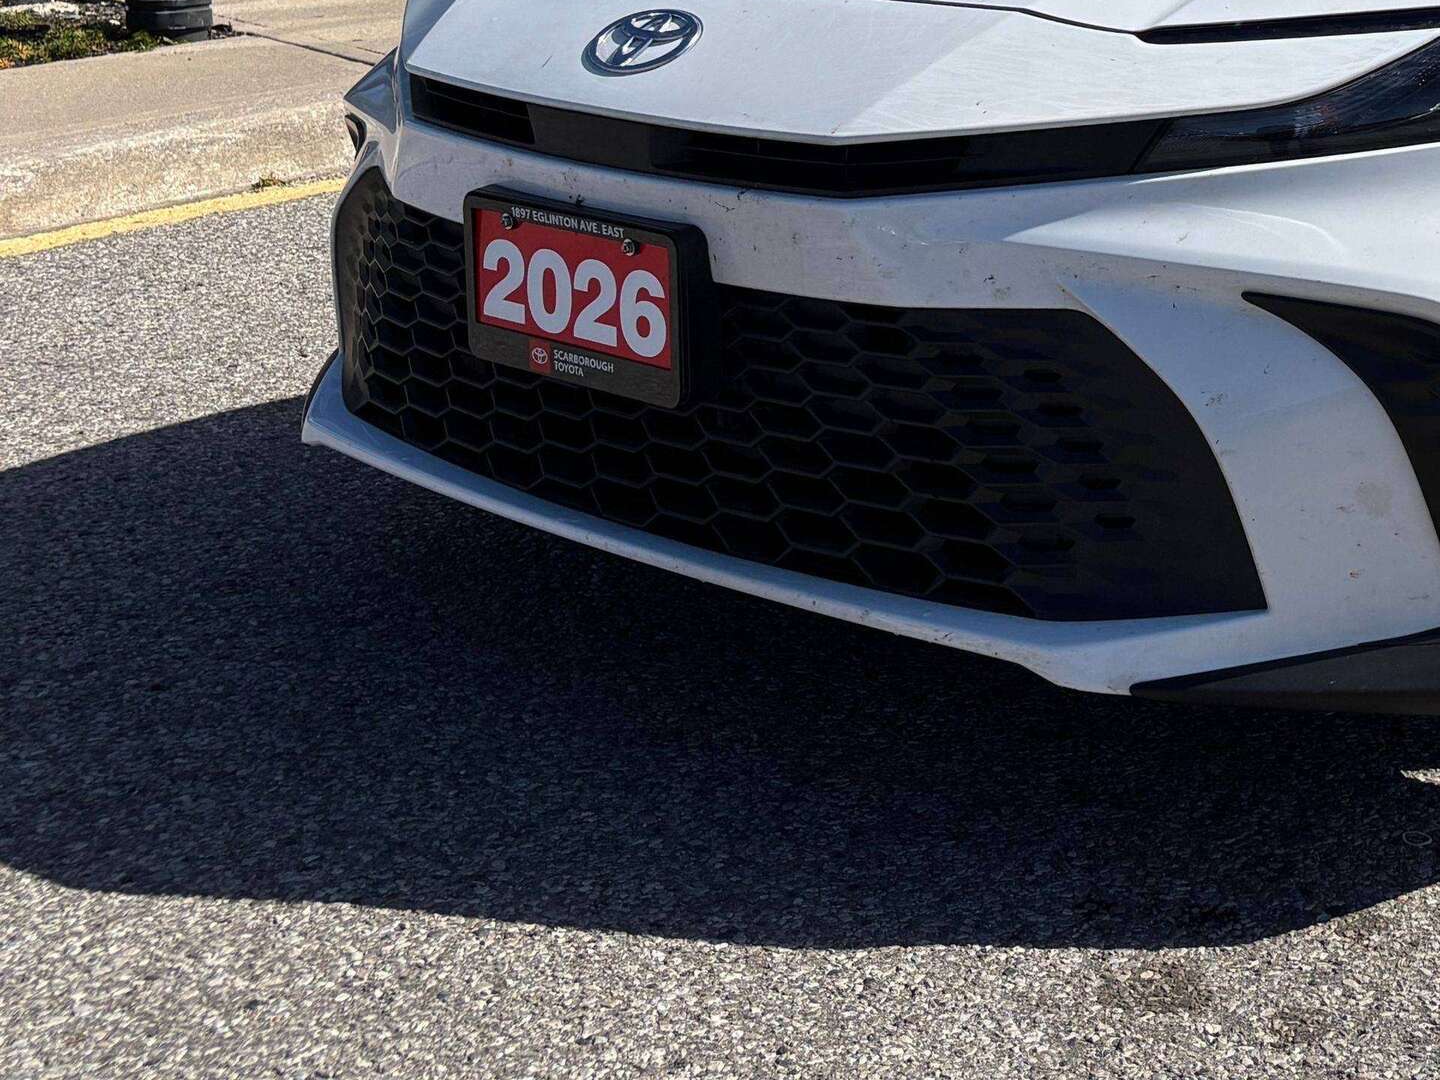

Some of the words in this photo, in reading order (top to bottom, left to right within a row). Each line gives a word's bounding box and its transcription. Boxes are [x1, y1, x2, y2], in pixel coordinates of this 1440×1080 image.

[511, 206, 531, 220] 1897
[532, 210, 578, 232] EGLINTON
[579, 221, 601, 235] AVE.
[601, 223, 625, 239] EAST
[482, 238, 668, 358] 2026
[553, 349, 614, 374] SCARBOROUGH
[553, 361, 584, 377] TOYOTA
